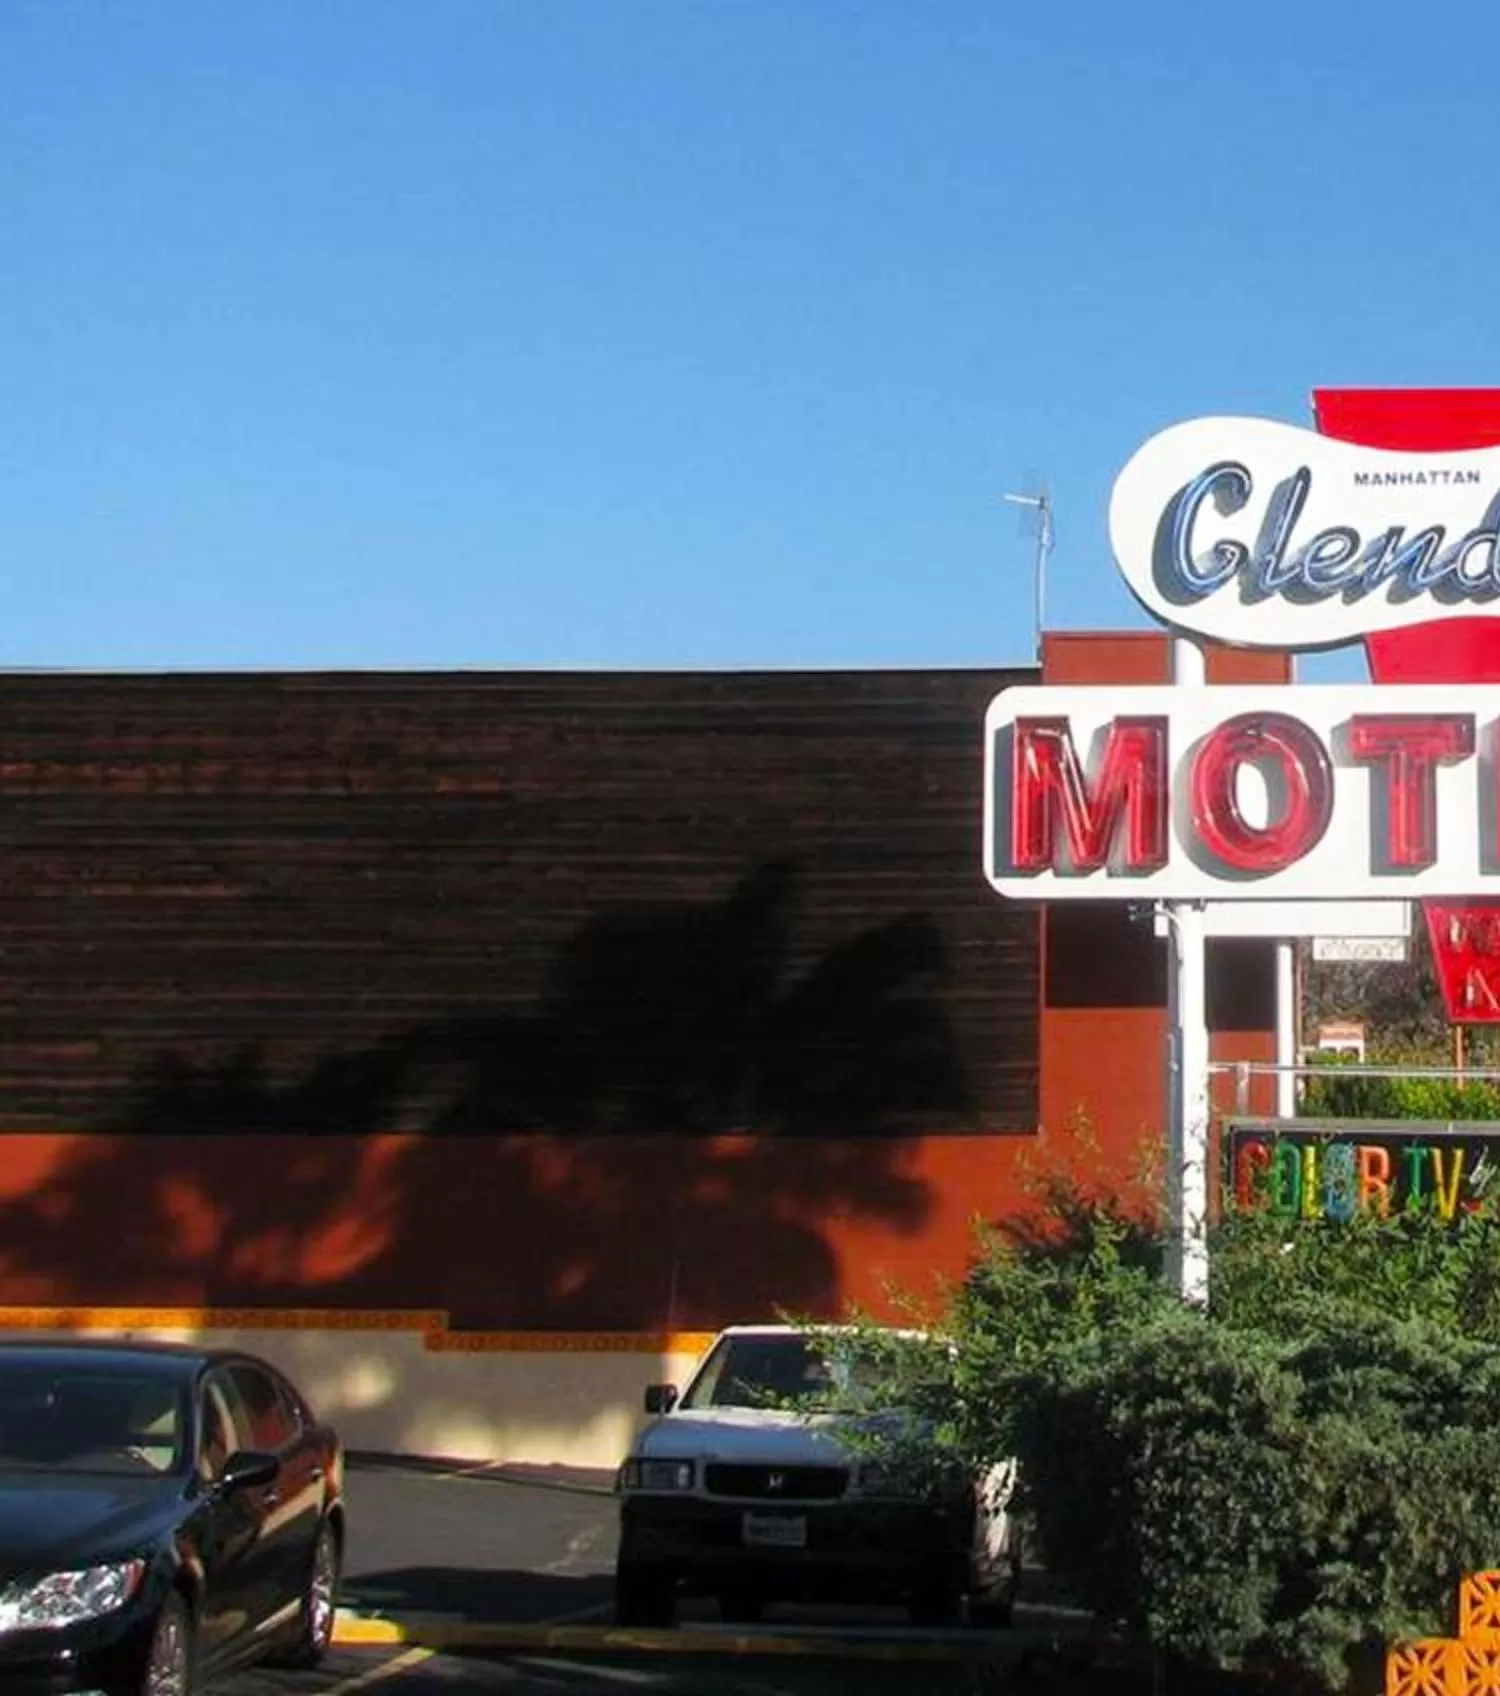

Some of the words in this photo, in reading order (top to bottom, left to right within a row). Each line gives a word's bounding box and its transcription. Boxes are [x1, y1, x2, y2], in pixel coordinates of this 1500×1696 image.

[1353, 469, 1480, 486] MANHATTAN
[1234, 1138, 1390, 1223] COLOR
[1403, 1142, 1464, 1223] TV
